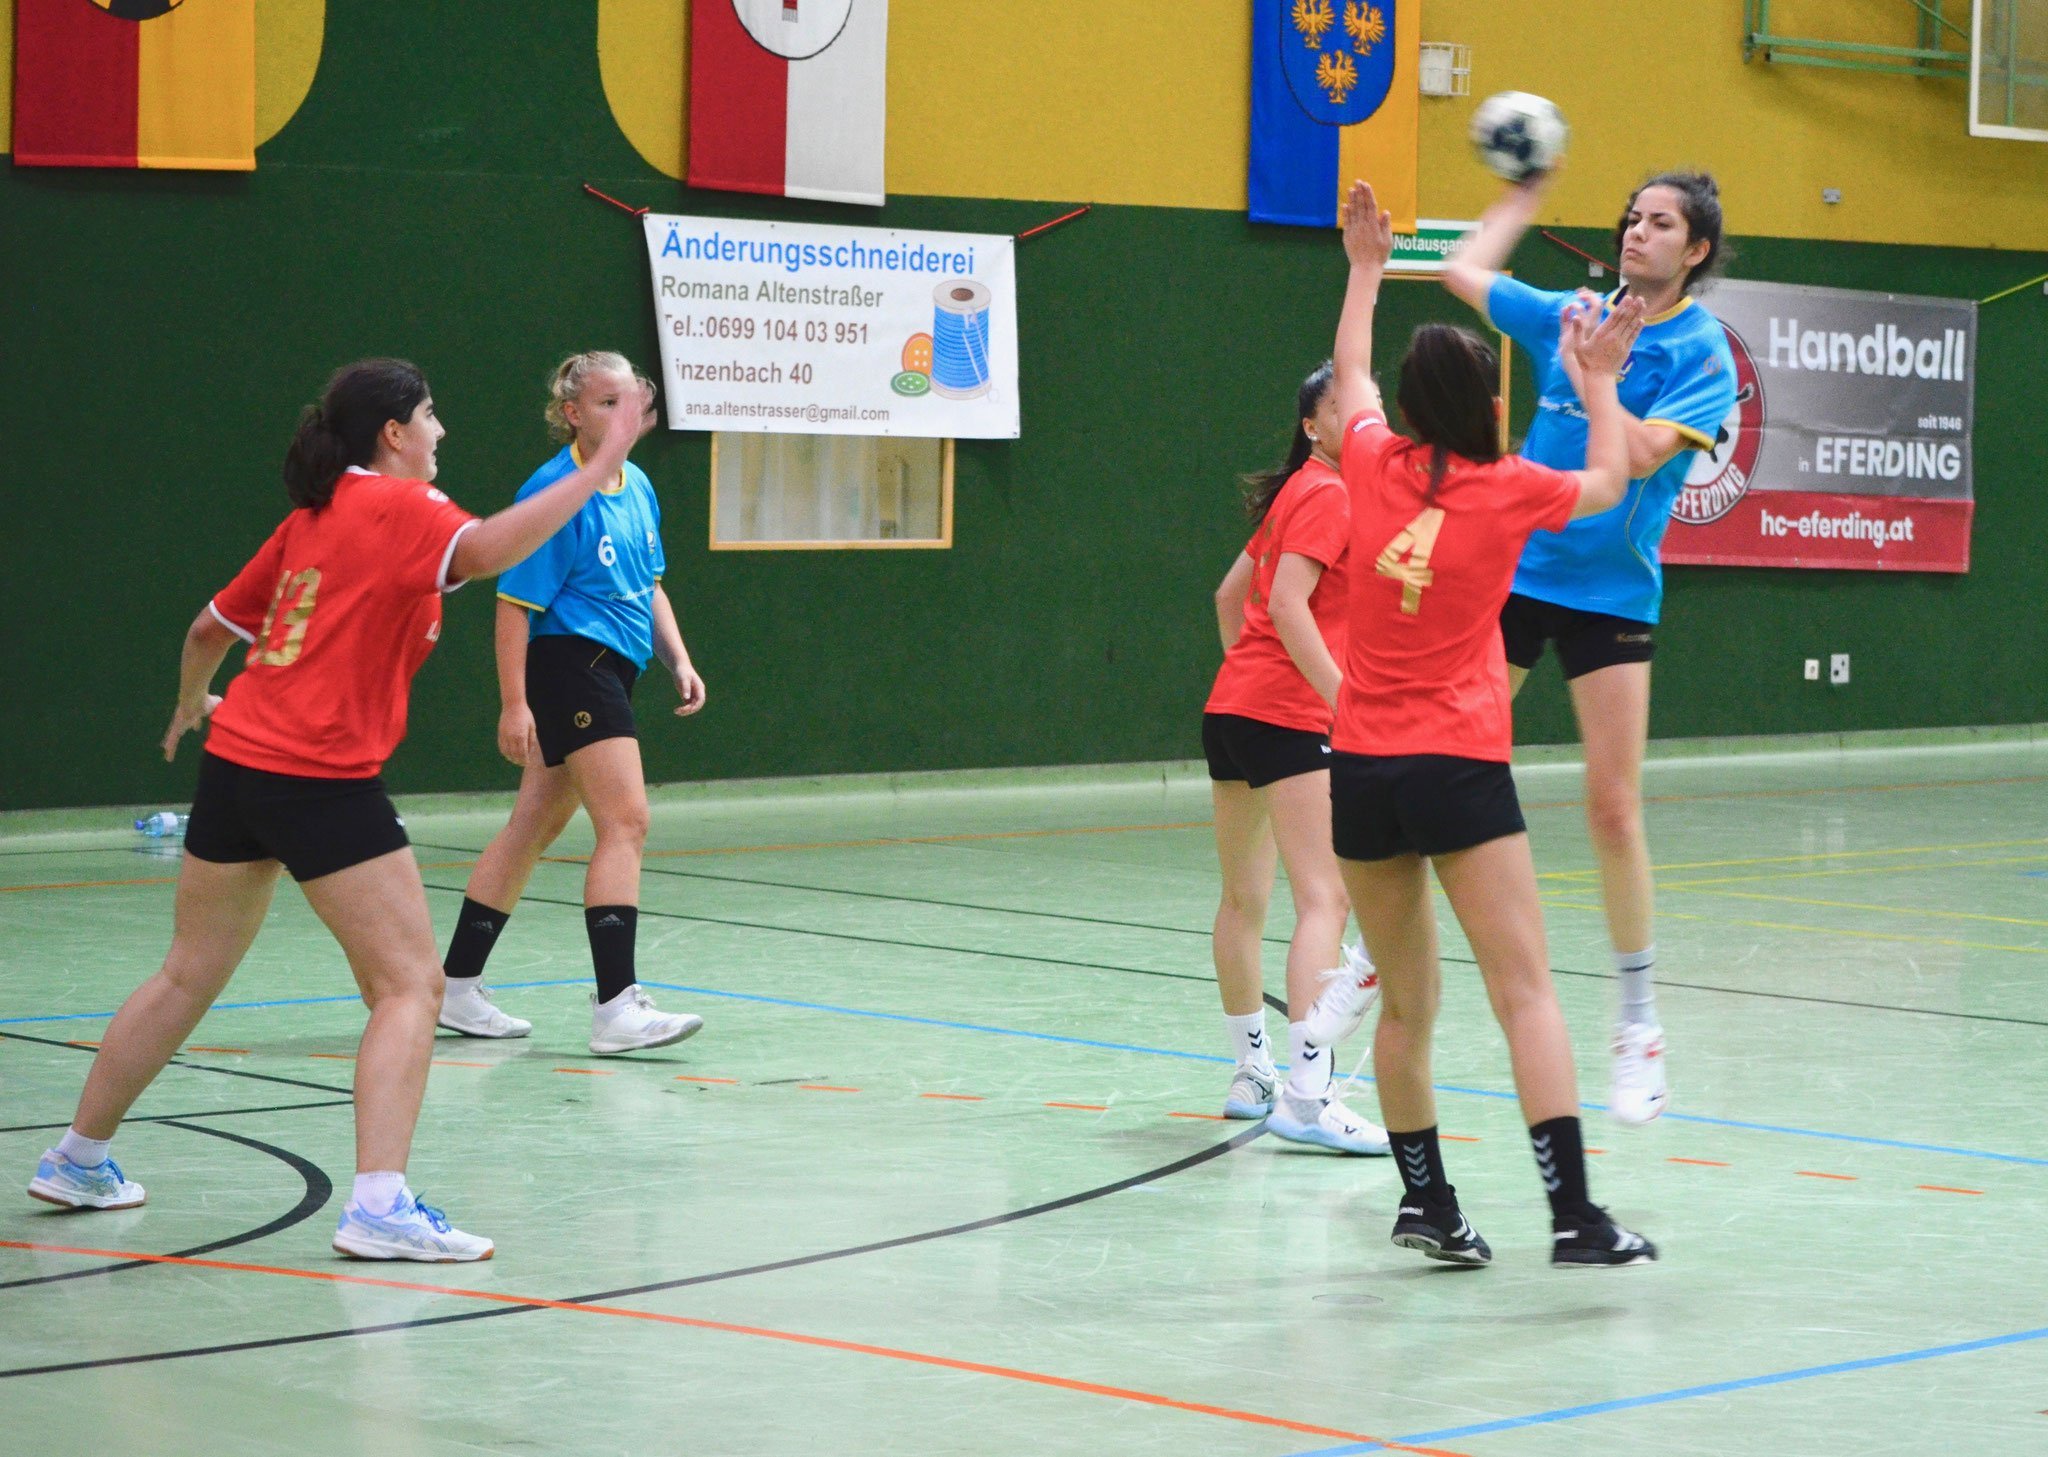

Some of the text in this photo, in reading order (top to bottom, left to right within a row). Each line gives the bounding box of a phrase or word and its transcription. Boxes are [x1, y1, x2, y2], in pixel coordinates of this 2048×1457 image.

[661, 222, 975, 275] Änderungsschneiderei
[661, 275, 883, 308] Romana Altenstraßer
[763, 319, 798, 341] 104
[805, 321, 828, 343] 03
[835, 322, 868, 345] 951
[1768, 317, 1966, 381] Handball
[789, 362, 813, 385] 40
[1917, 414, 1938, 431] seit
[1798, 436, 1961, 481] in EFERDING
[1760, 509, 1914, 549] hc-eferding.at
[597, 534, 617, 567] 6
[1375, 506, 1446, 616] 4
[246, 567, 322, 667] 13
